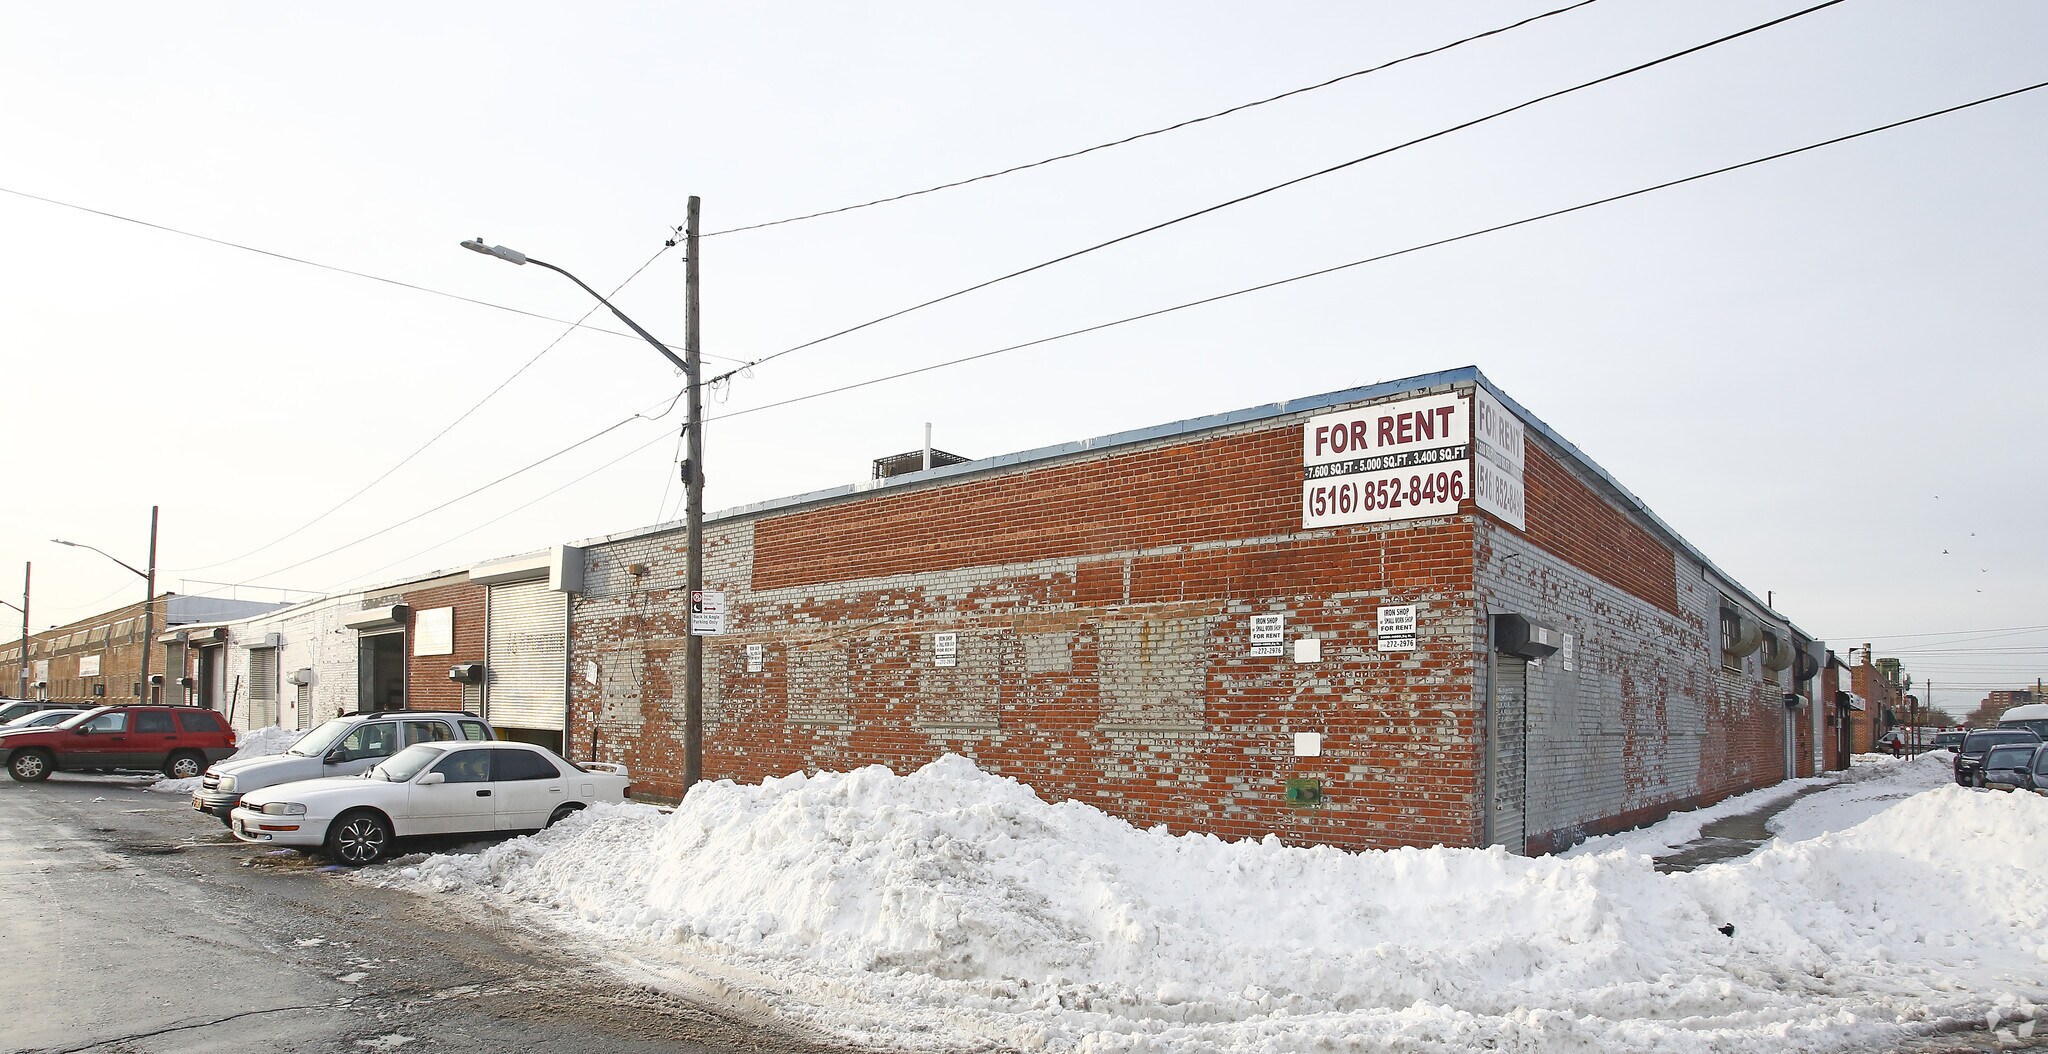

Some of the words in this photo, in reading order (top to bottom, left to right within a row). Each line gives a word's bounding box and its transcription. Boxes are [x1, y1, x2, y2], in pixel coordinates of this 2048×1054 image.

[1315, 420, 1368, 457] FOR
[1377, 405, 1455, 448] RENT
[1499, 415, 1520, 458] RENT
[1330, 461, 1354, 476] SQ.FT
[1359, 458, 1382, 472] 5.000
[1383, 454, 1408, 468] SQ.FT
[1413, 450, 1437, 464] 3.400
[1439, 446, 1466, 460] SQ.FT
[1309, 482, 1358, 517] (516)
[1364, 469, 1464, 511] 852-8496
[1266, 616, 1278, 624] SHOP
[1396, 608, 1410, 616] SHOP
[1386, 639, 1414, 647] 272-2976
